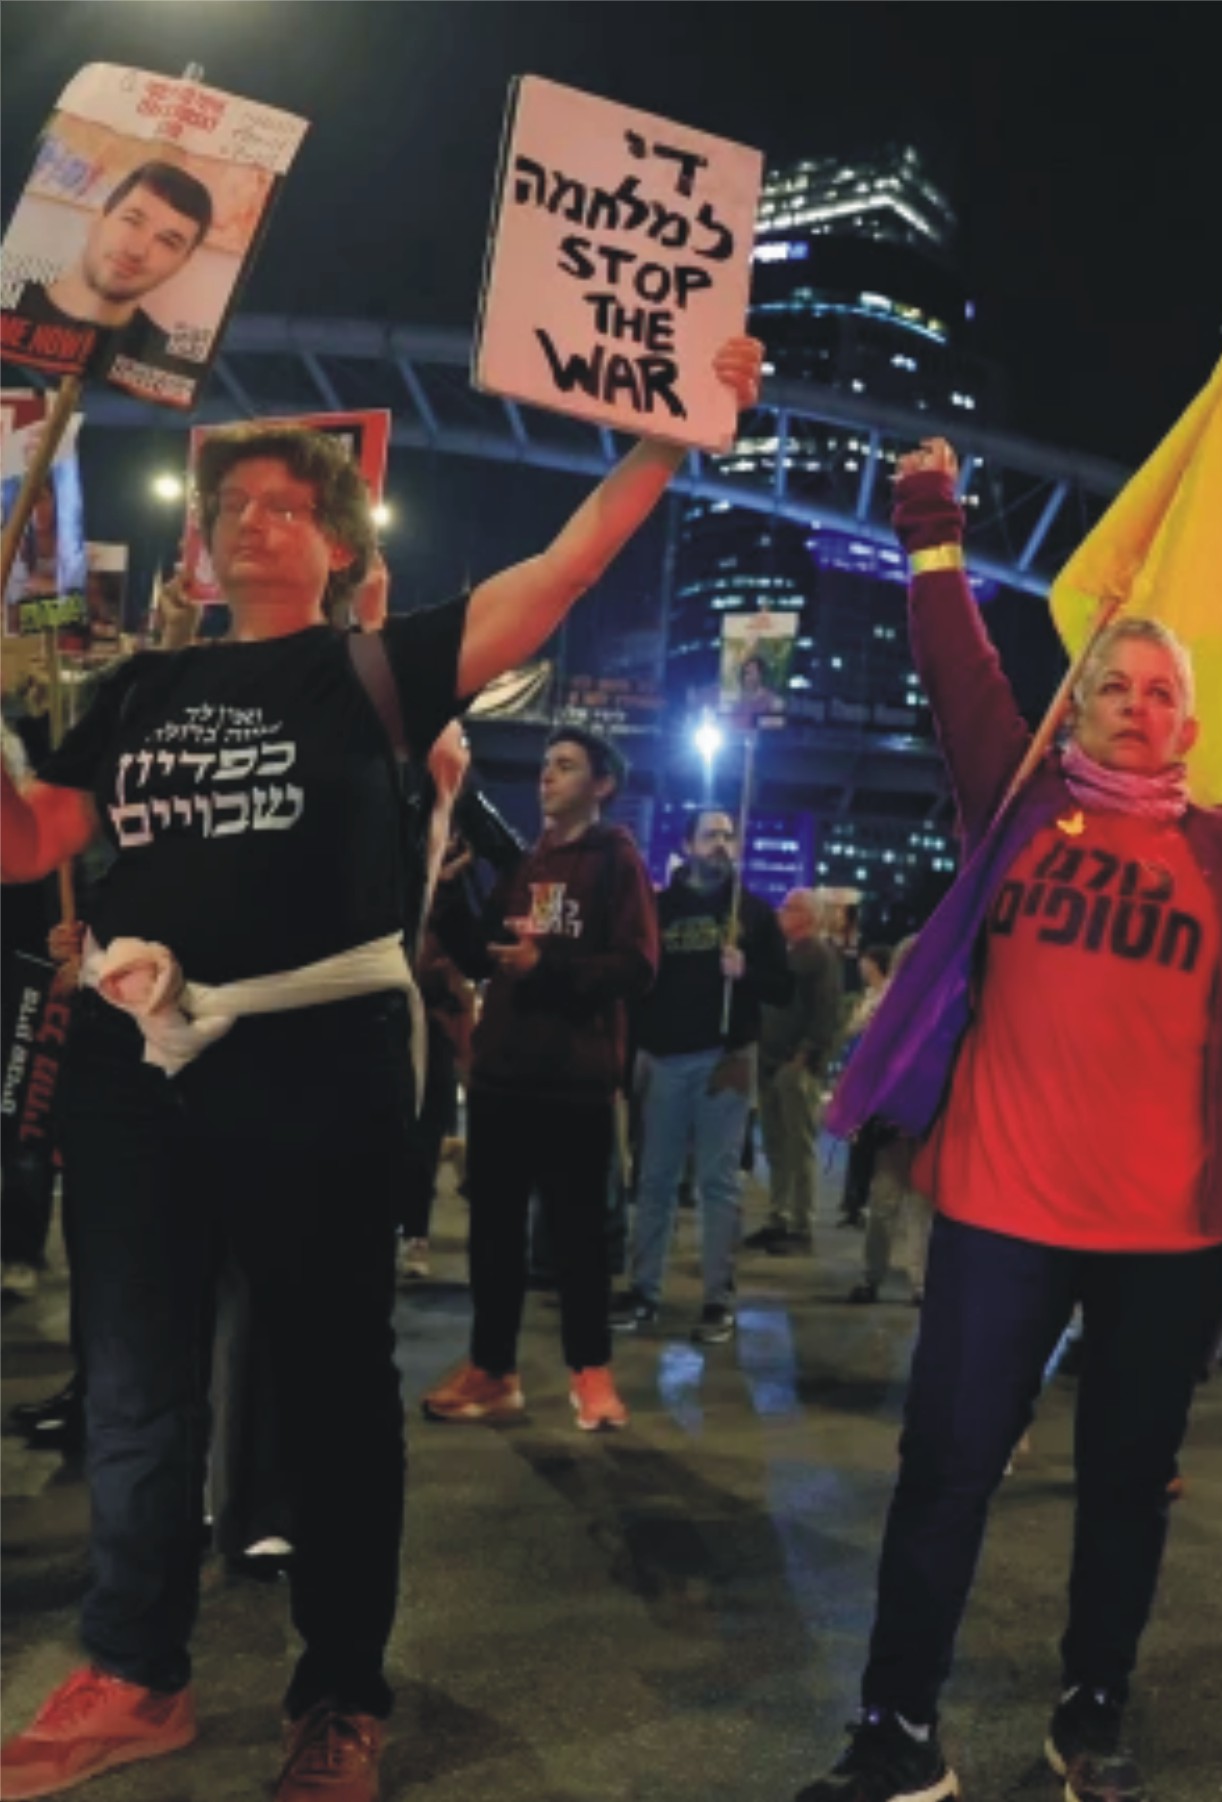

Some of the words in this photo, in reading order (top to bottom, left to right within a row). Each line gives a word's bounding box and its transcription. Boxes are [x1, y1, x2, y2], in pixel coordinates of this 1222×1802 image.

[624, 129, 708, 197] די
[514, 154, 735, 261] למלחמה
[557, 234, 713, 310] STOP
[583, 293, 676, 355] THE
[534, 327, 688, 421] WAR
[114, 740, 297, 807] כפדיון
[107, 782, 305, 848] שבויים
[990, 879, 1203, 974] חטופים
